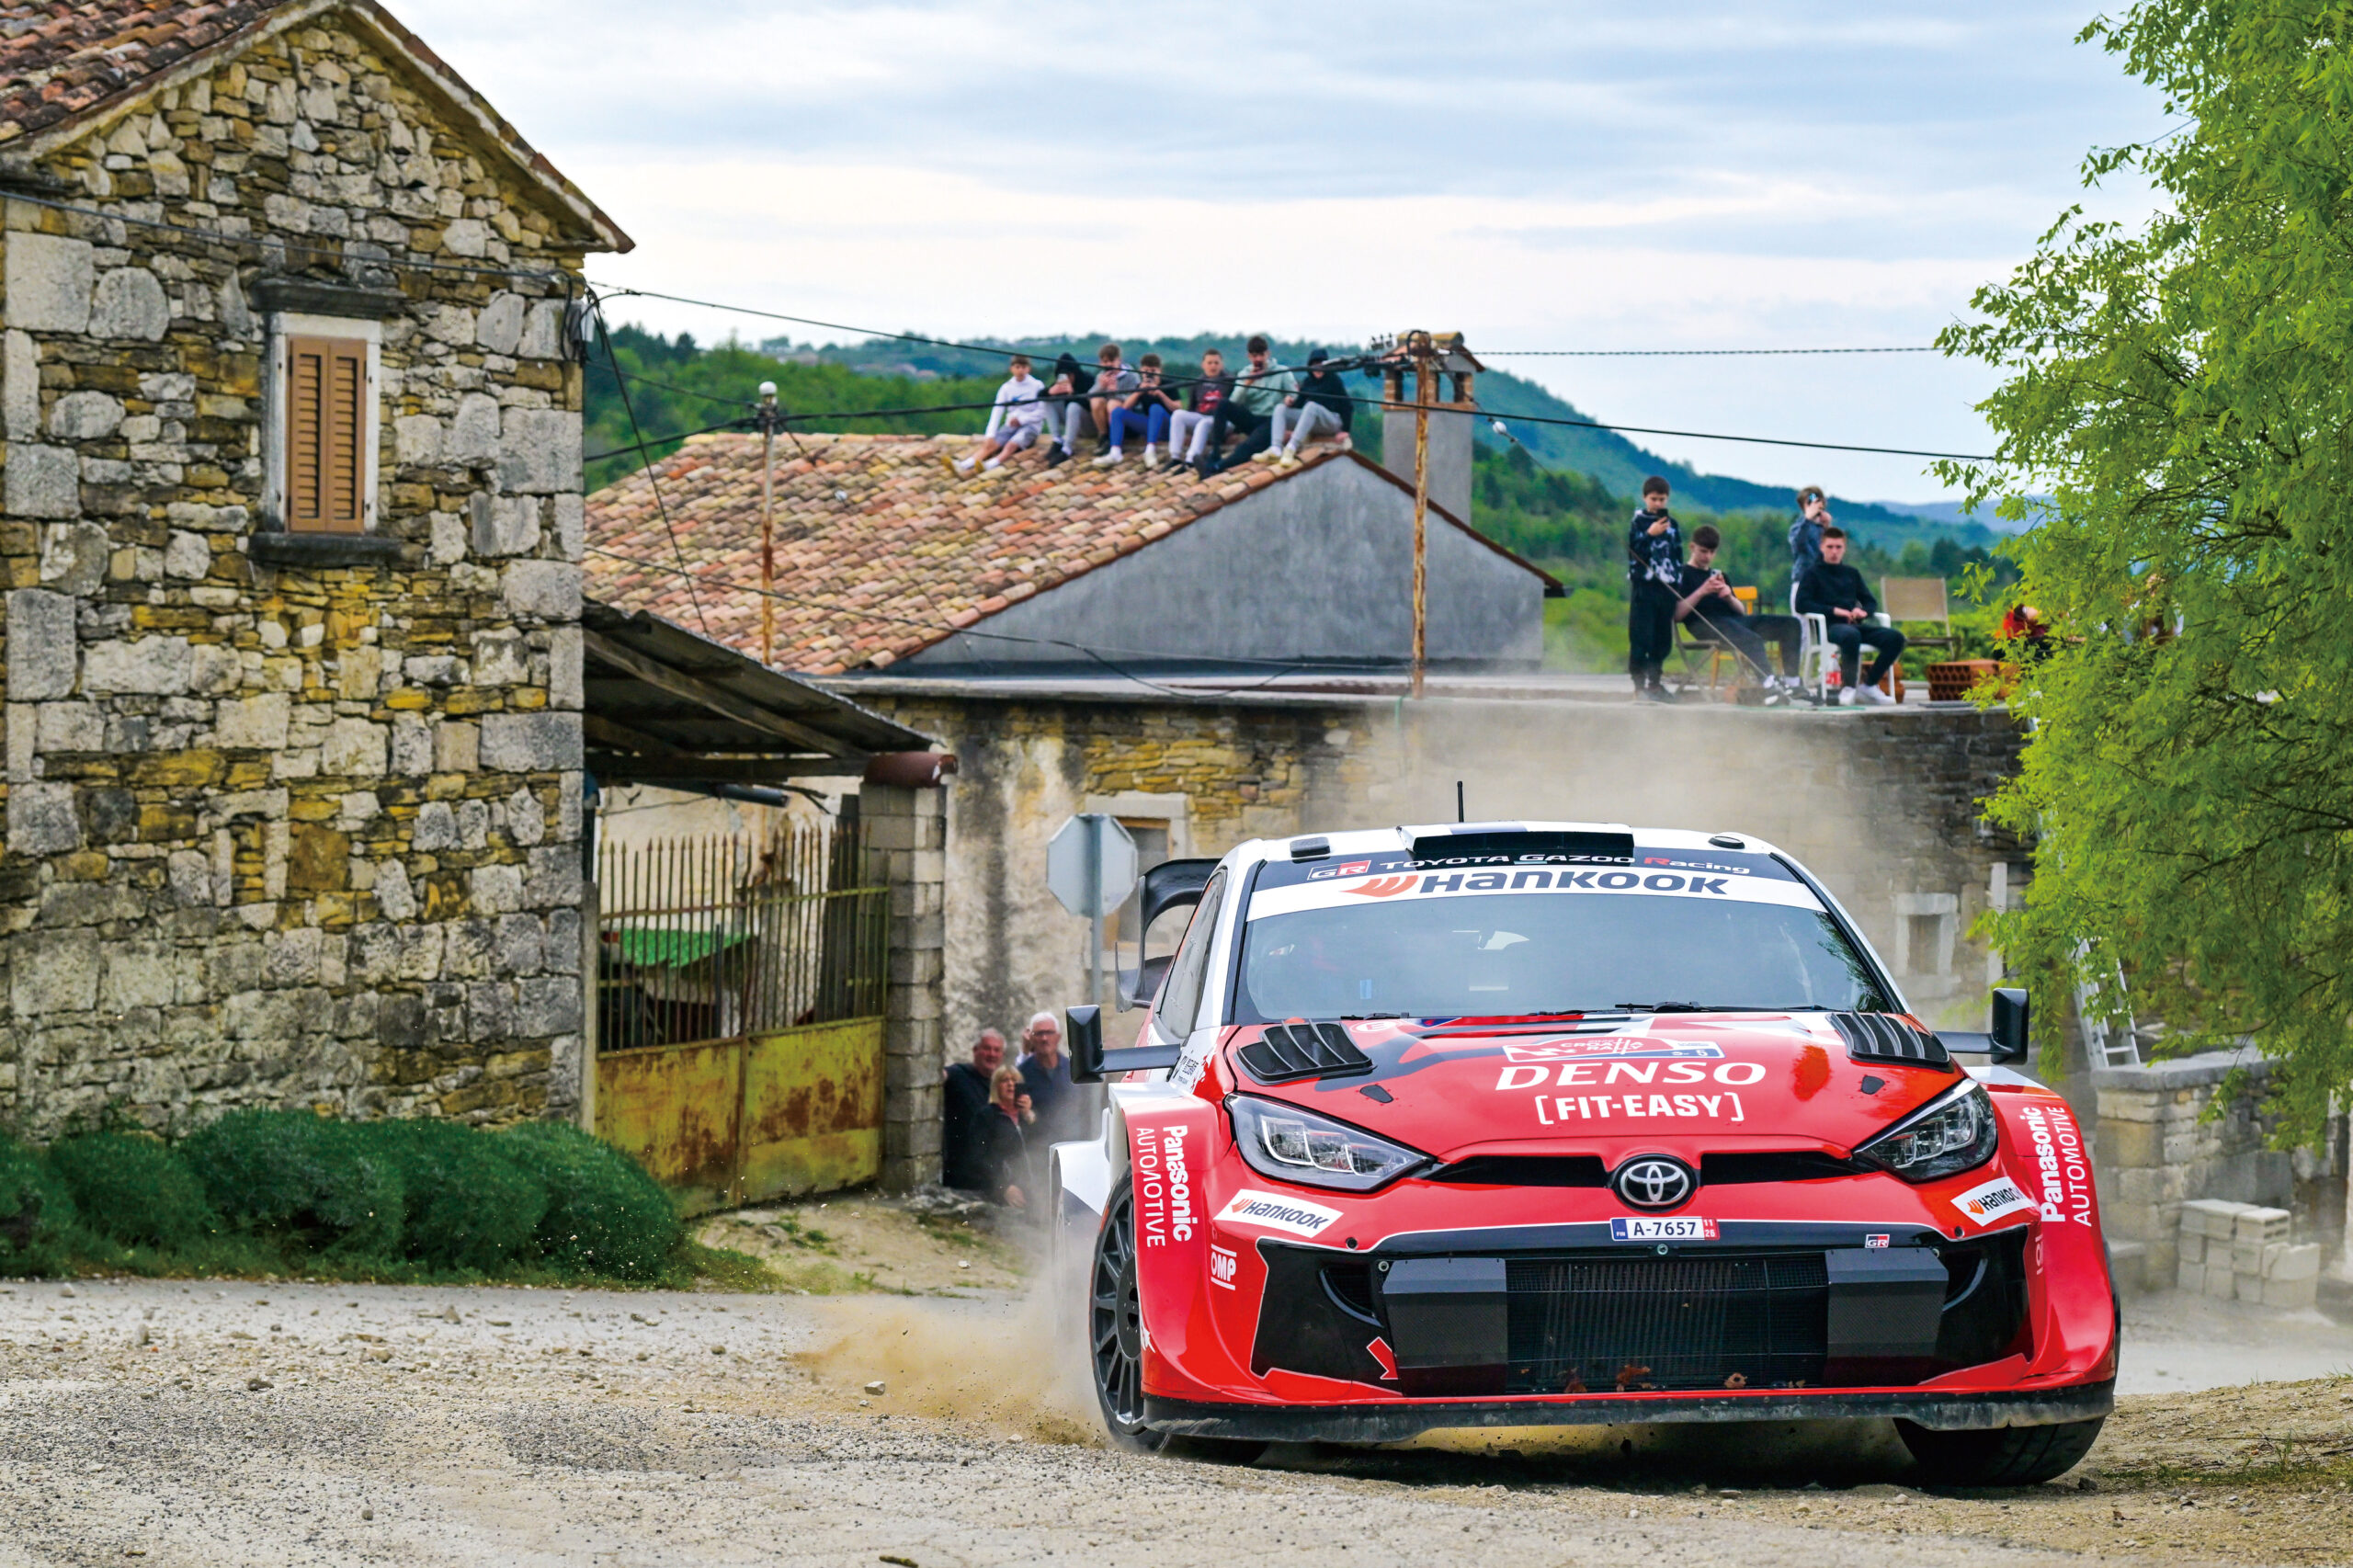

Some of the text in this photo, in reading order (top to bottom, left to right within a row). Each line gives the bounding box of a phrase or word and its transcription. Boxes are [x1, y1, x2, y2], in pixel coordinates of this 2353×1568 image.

[1311, 854, 1750, 879] GR TOYOTA GAZOO Racing
[1495, 1062, 1766, 1090] DENSO
[2019, 1107, 2066, 1222] Panasonic
[2046, 1107, 2092, 1227] AUTOMOTIVE
[1136, 1127, 1165, 1248] AUTOMOTIVE
[1163, 1125, 1199, 1242] Panasonic
[1633, 1221, 1696, 1236] A-7657
[1705, 1229, 1716, 1238] 26
[1867, 1237, 1888, 1247] GR
[1211, 1251, 1236, 1282] OMP
